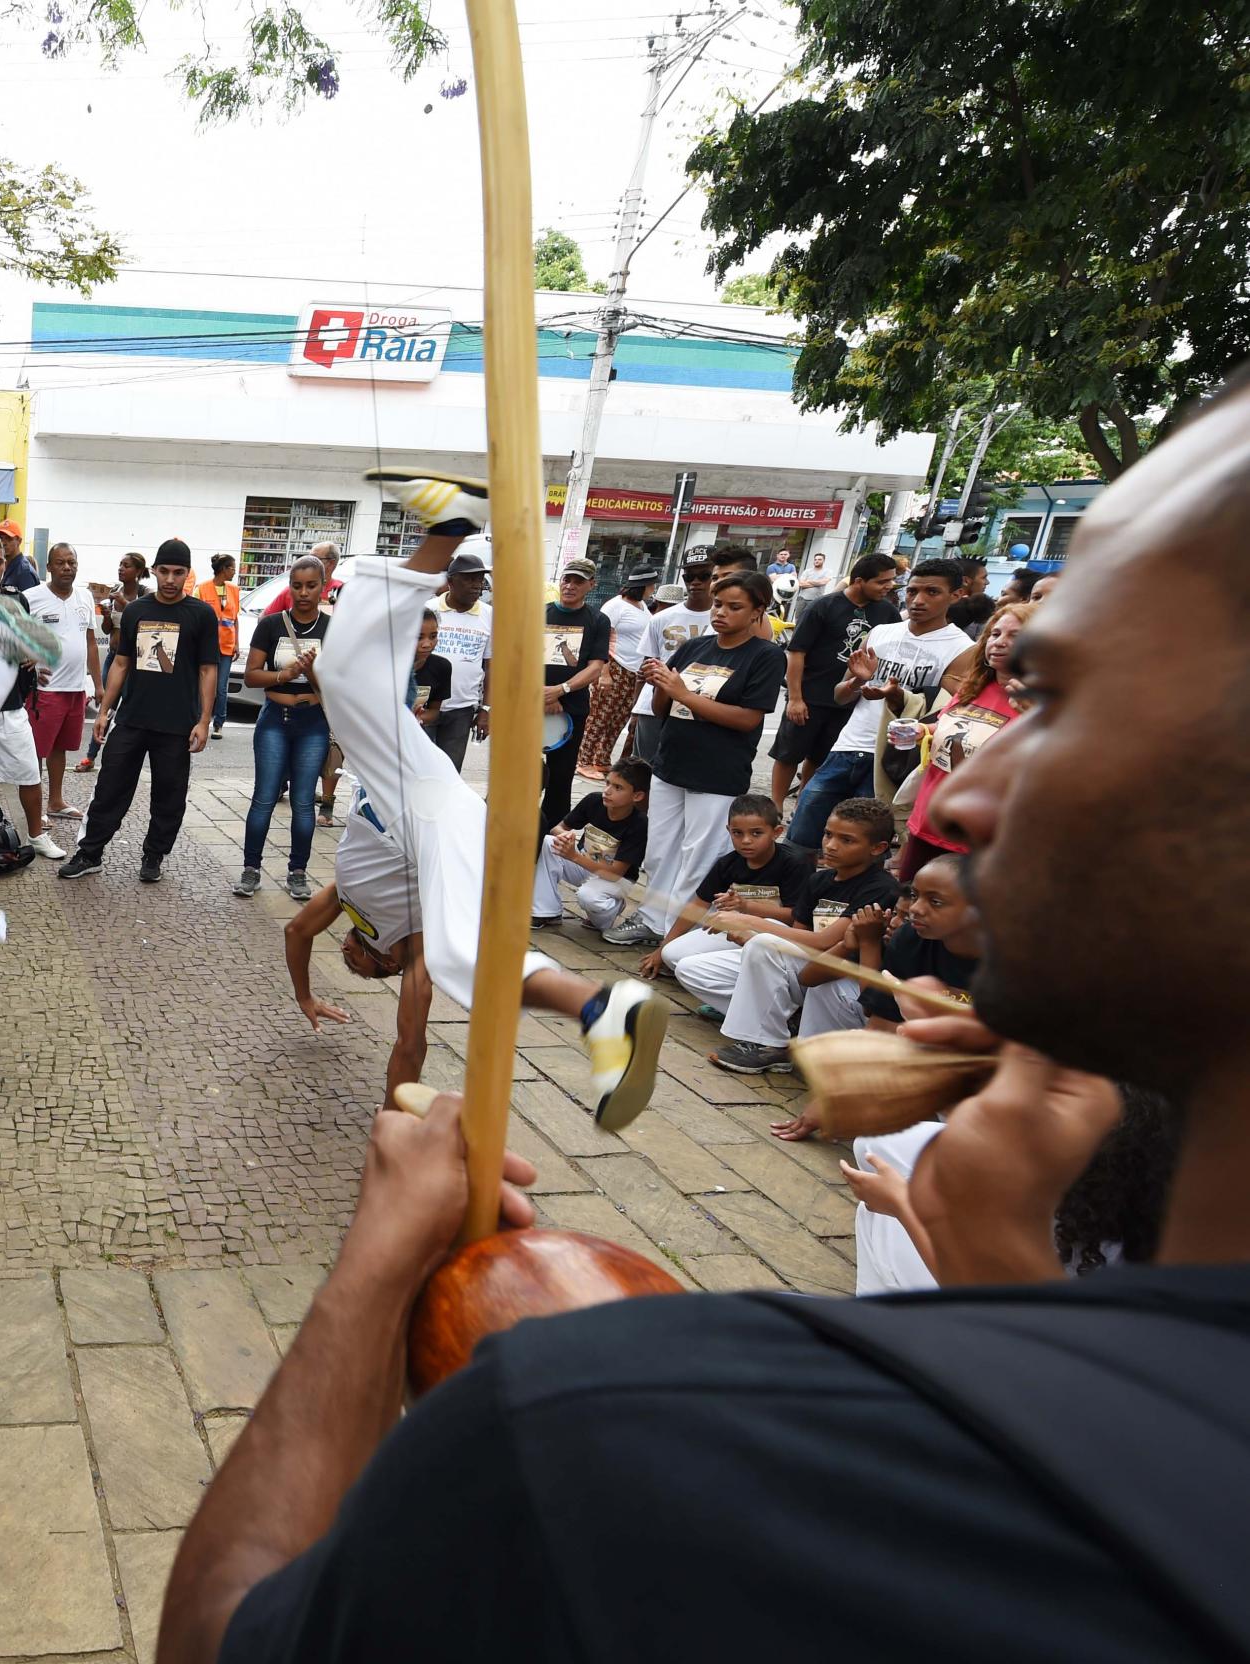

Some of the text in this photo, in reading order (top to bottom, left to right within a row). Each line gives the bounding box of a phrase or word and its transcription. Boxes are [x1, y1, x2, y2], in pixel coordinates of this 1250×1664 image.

[368, 312, 418, 328] Droga
[359, 329, 437, 362] Raia
[586, 498, 663, 511] MEDICAMENTOS
[767, 507, 816, 519] DIABETES
[758, 888, 776, 897] Negro
